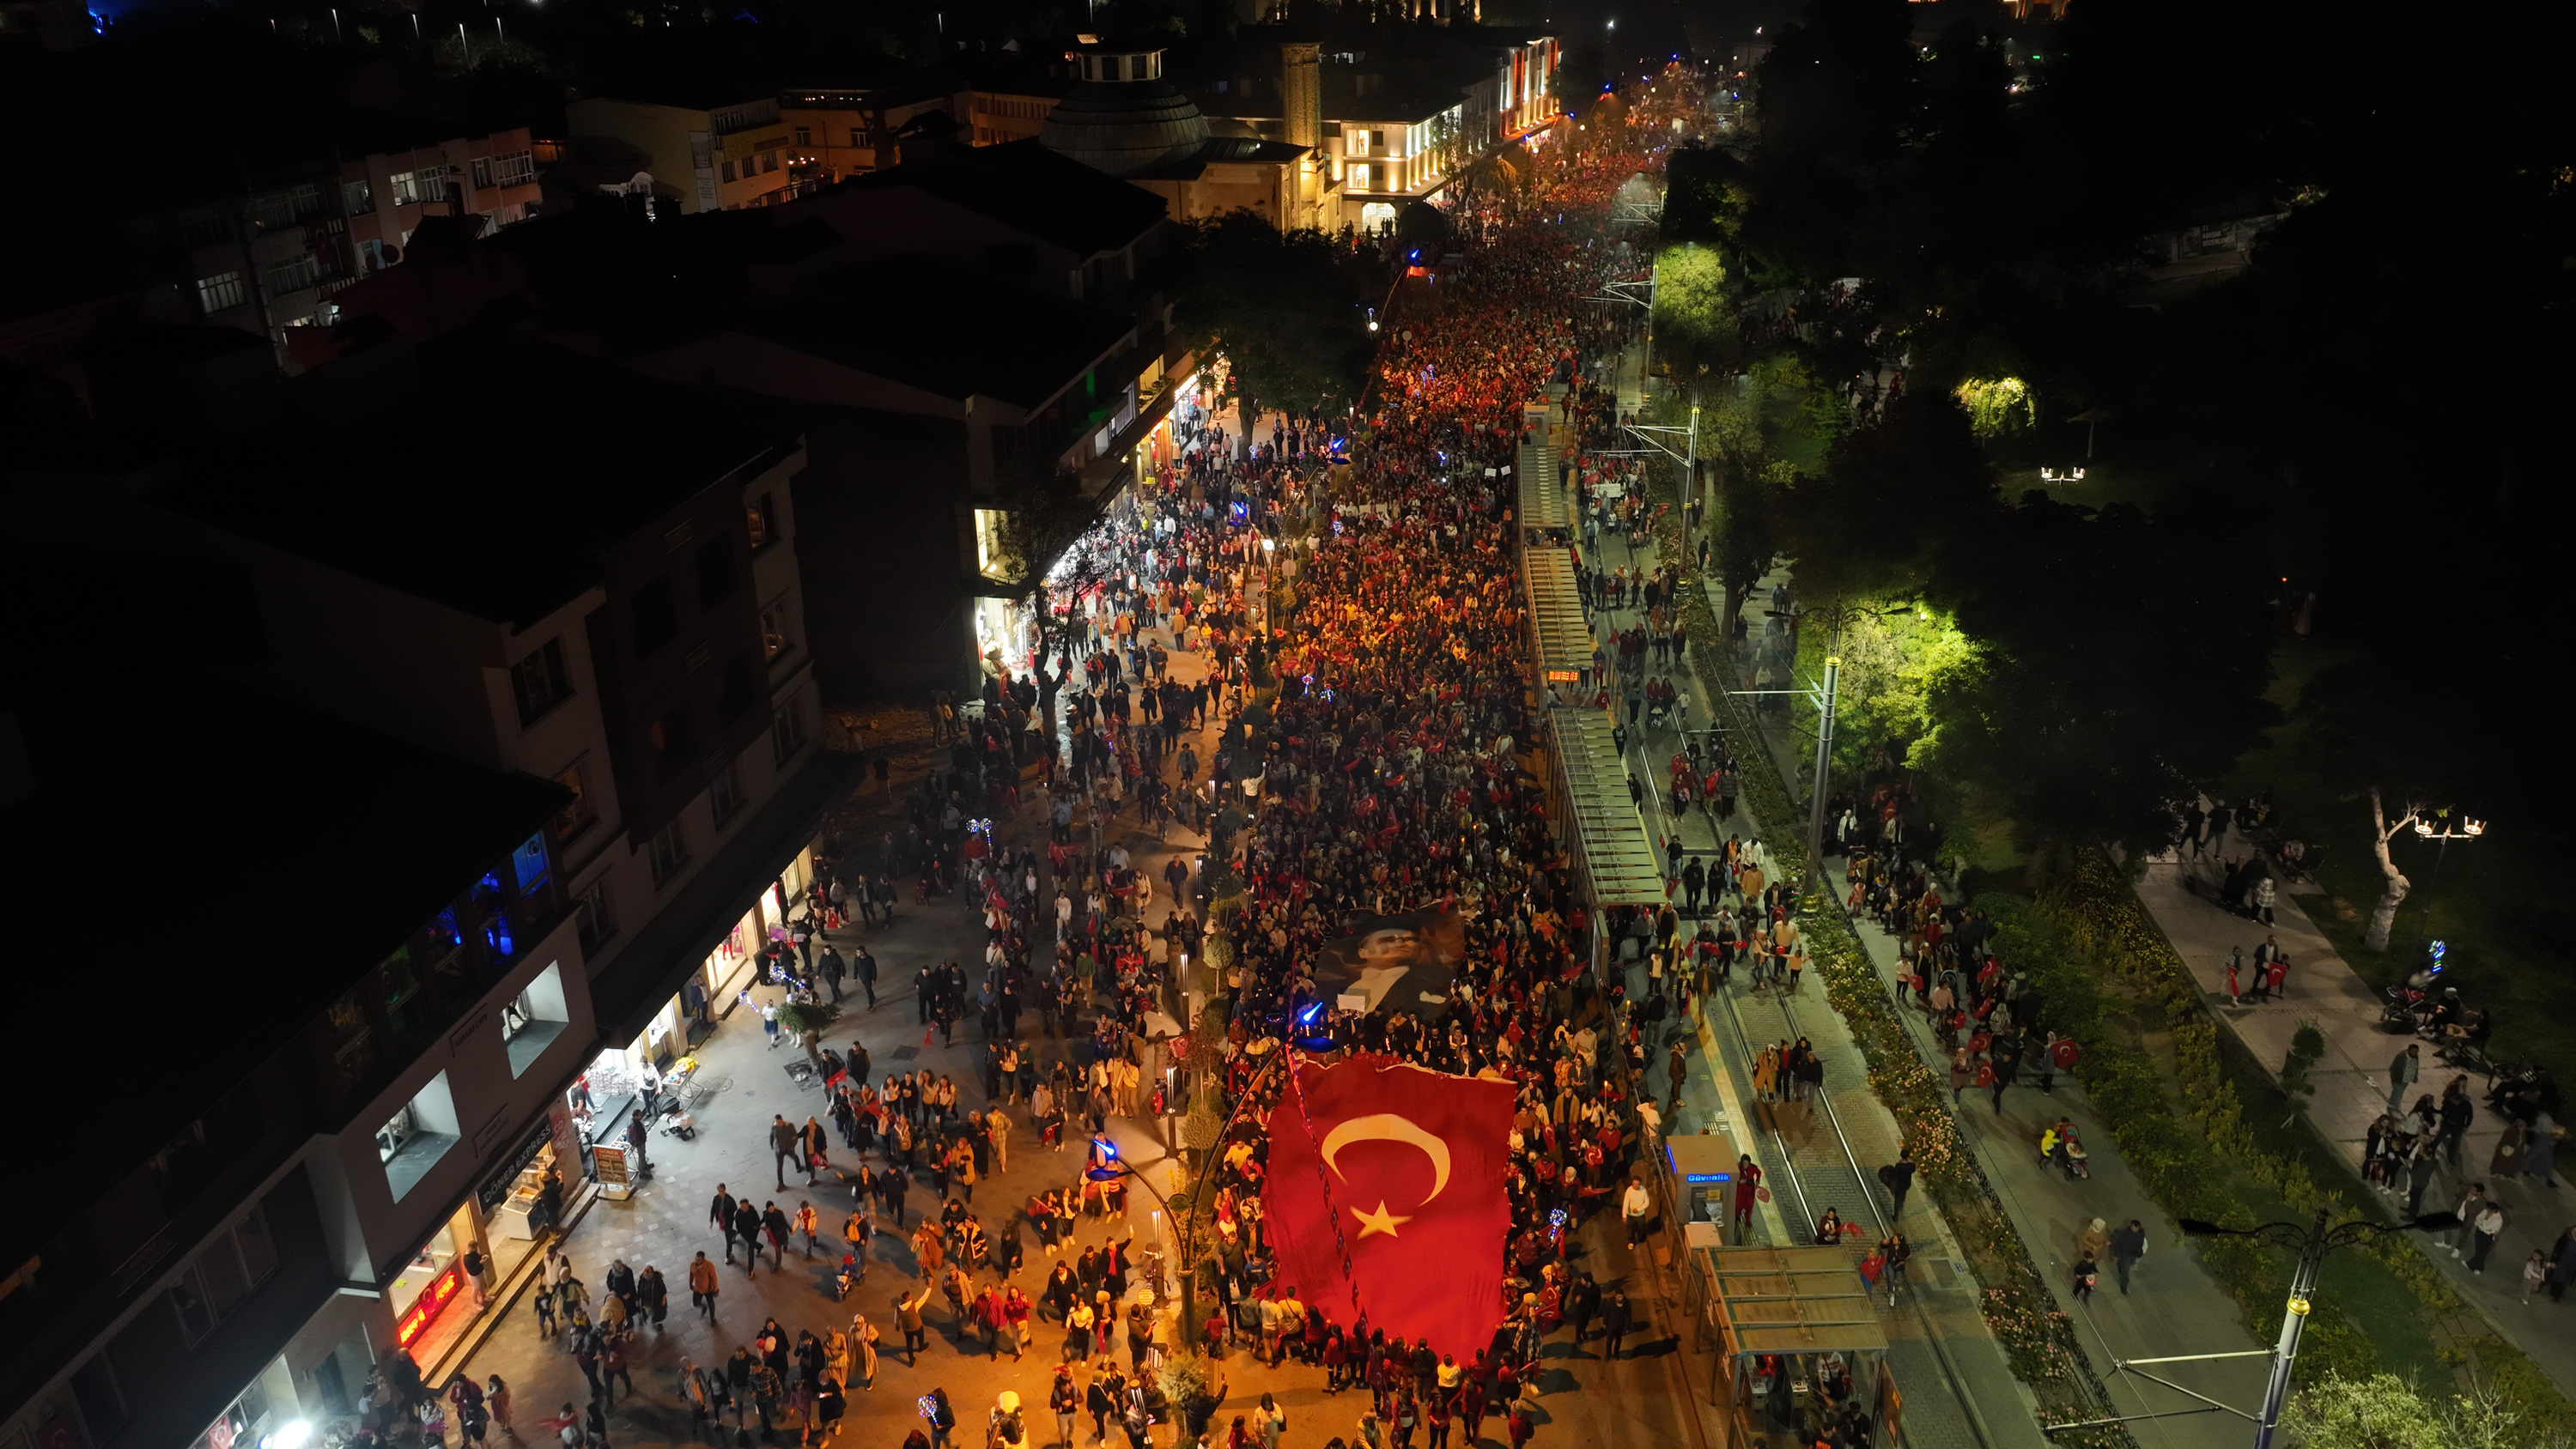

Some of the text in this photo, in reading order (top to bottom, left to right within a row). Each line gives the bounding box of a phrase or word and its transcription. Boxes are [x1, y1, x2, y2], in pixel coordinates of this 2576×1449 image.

[483, 1123, 551, 1203] DÖNER EXPRESS
[1687, 1173, 1729, 1182] Güvenlik
